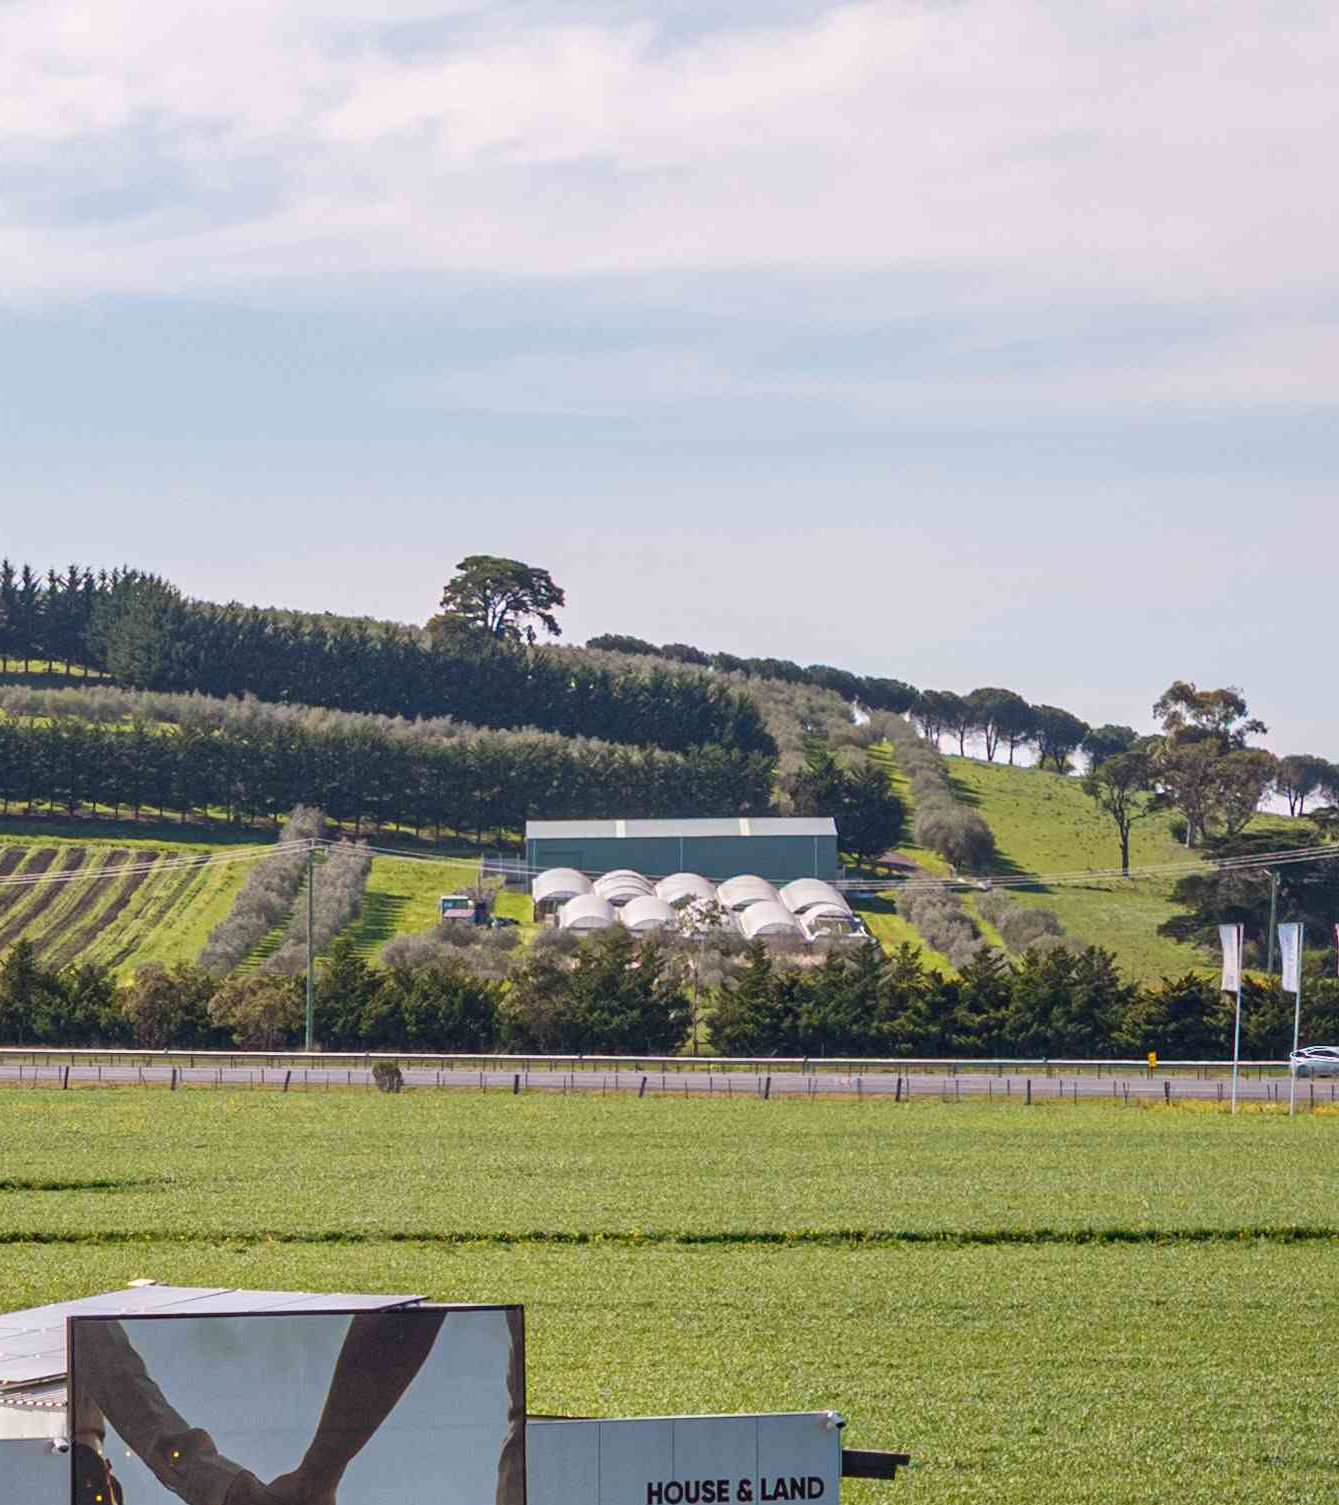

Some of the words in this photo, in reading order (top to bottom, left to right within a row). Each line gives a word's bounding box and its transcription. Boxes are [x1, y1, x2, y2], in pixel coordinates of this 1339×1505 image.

[646, 1480, 730, 1505] HOUSE
[736, 1478, 754, 1502] &
[760, 1476, 824, 1501] LAND
